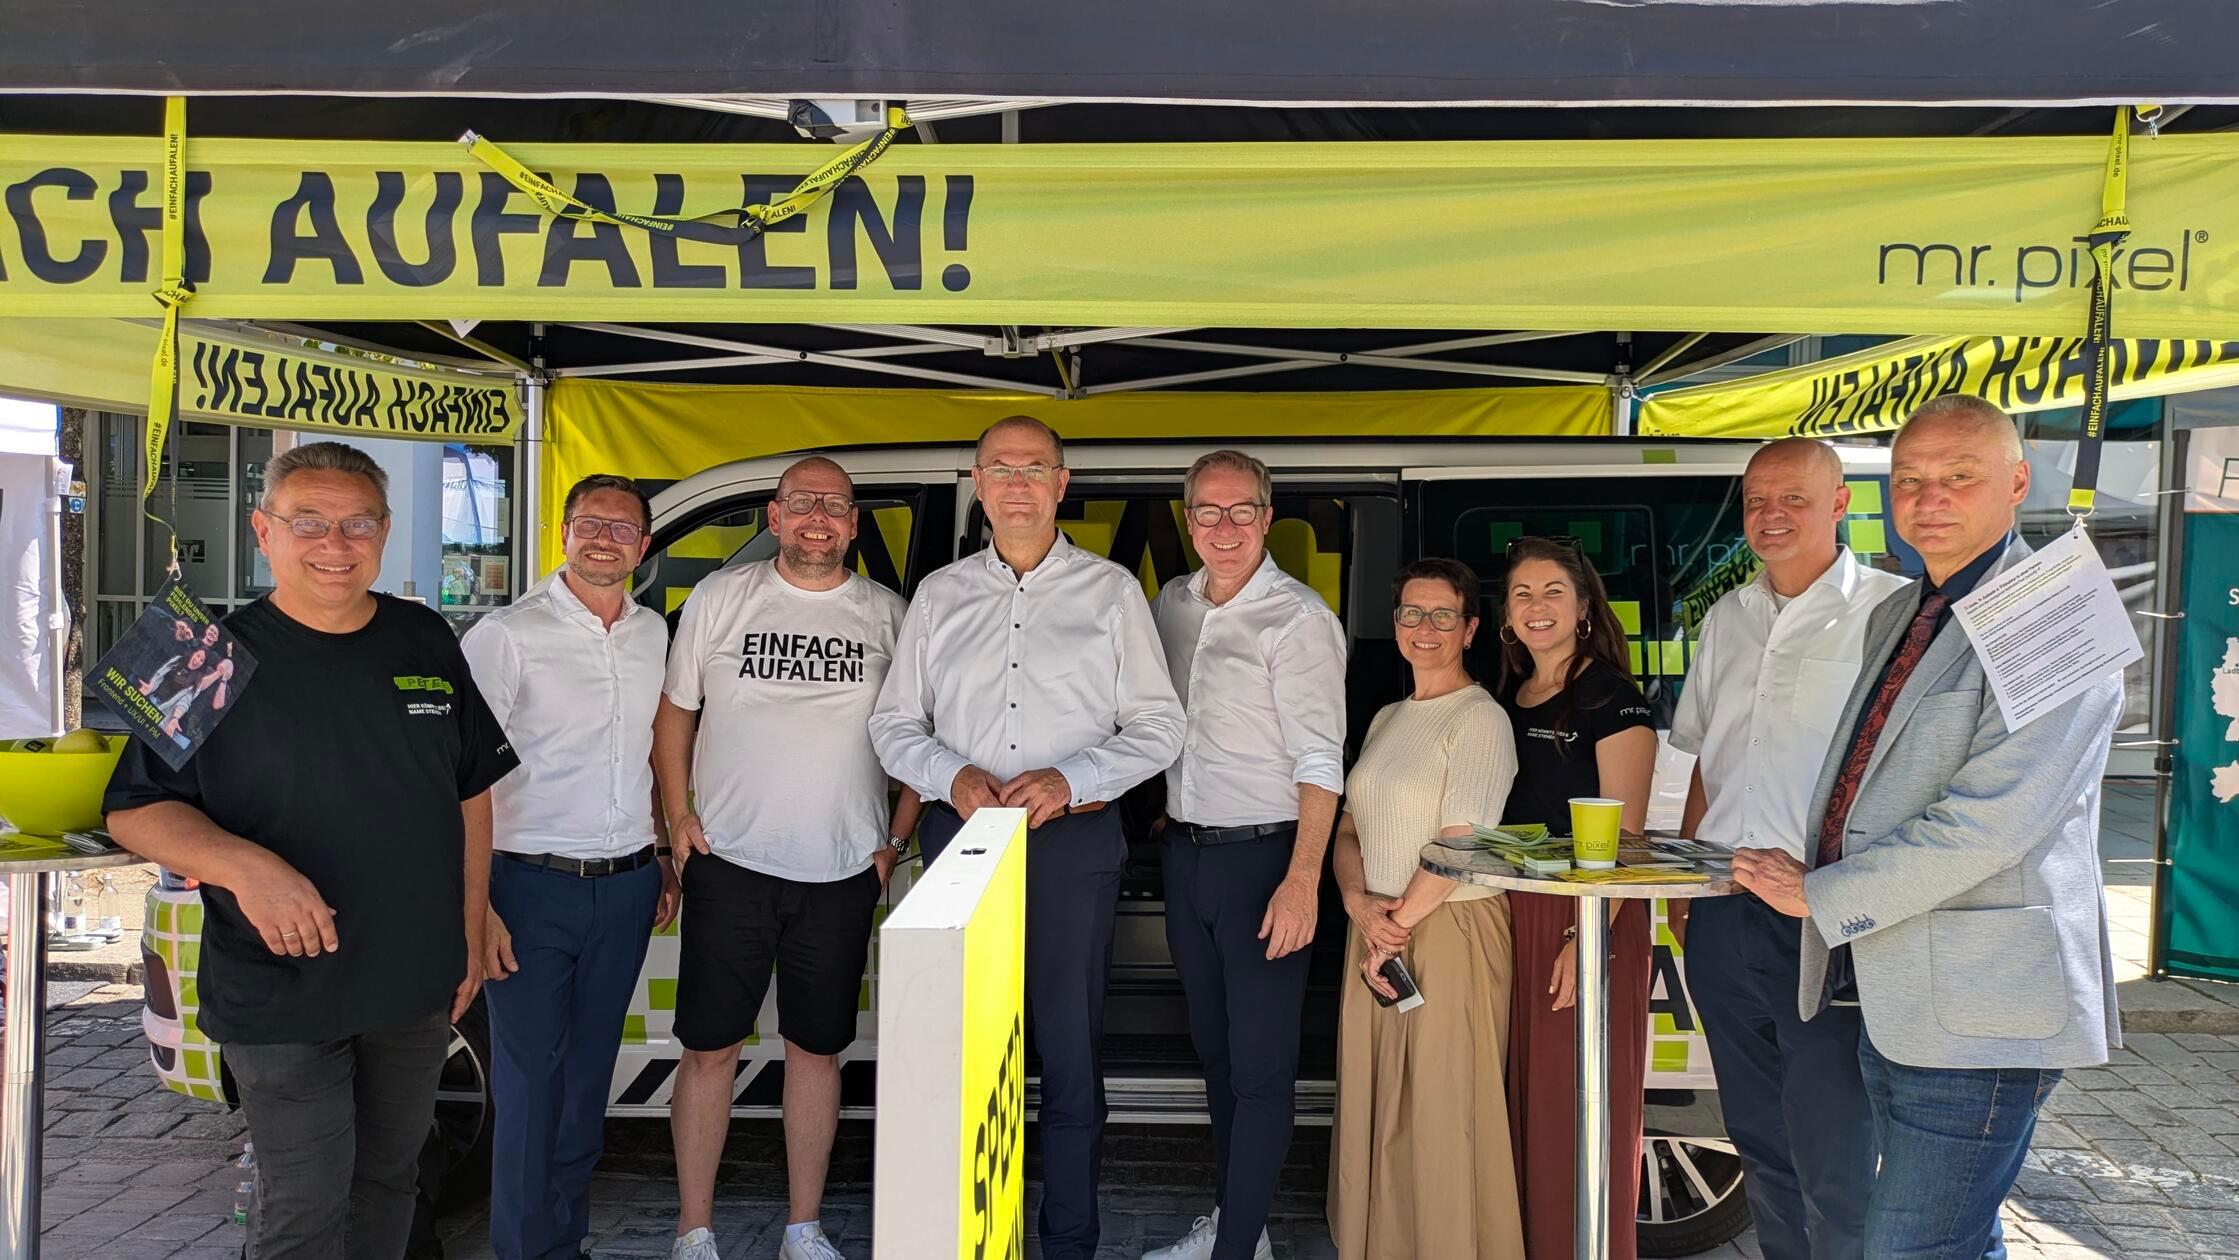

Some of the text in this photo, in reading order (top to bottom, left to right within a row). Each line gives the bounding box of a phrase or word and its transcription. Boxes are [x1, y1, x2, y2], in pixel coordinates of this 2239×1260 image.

[169, 133, 179, 220] #EINFACHAUFALEN!
[0, 167, 975, 292] CH AUFALEN!
[1878, 243, 1996, 286] mr.
[742, 632, 864, 662] EINFACH
[738, 656, 864, 683] AUFALEN!
[97, 678, 124, 705] Frontend
[106, 667, 162, 723] WIR SUCHEN
